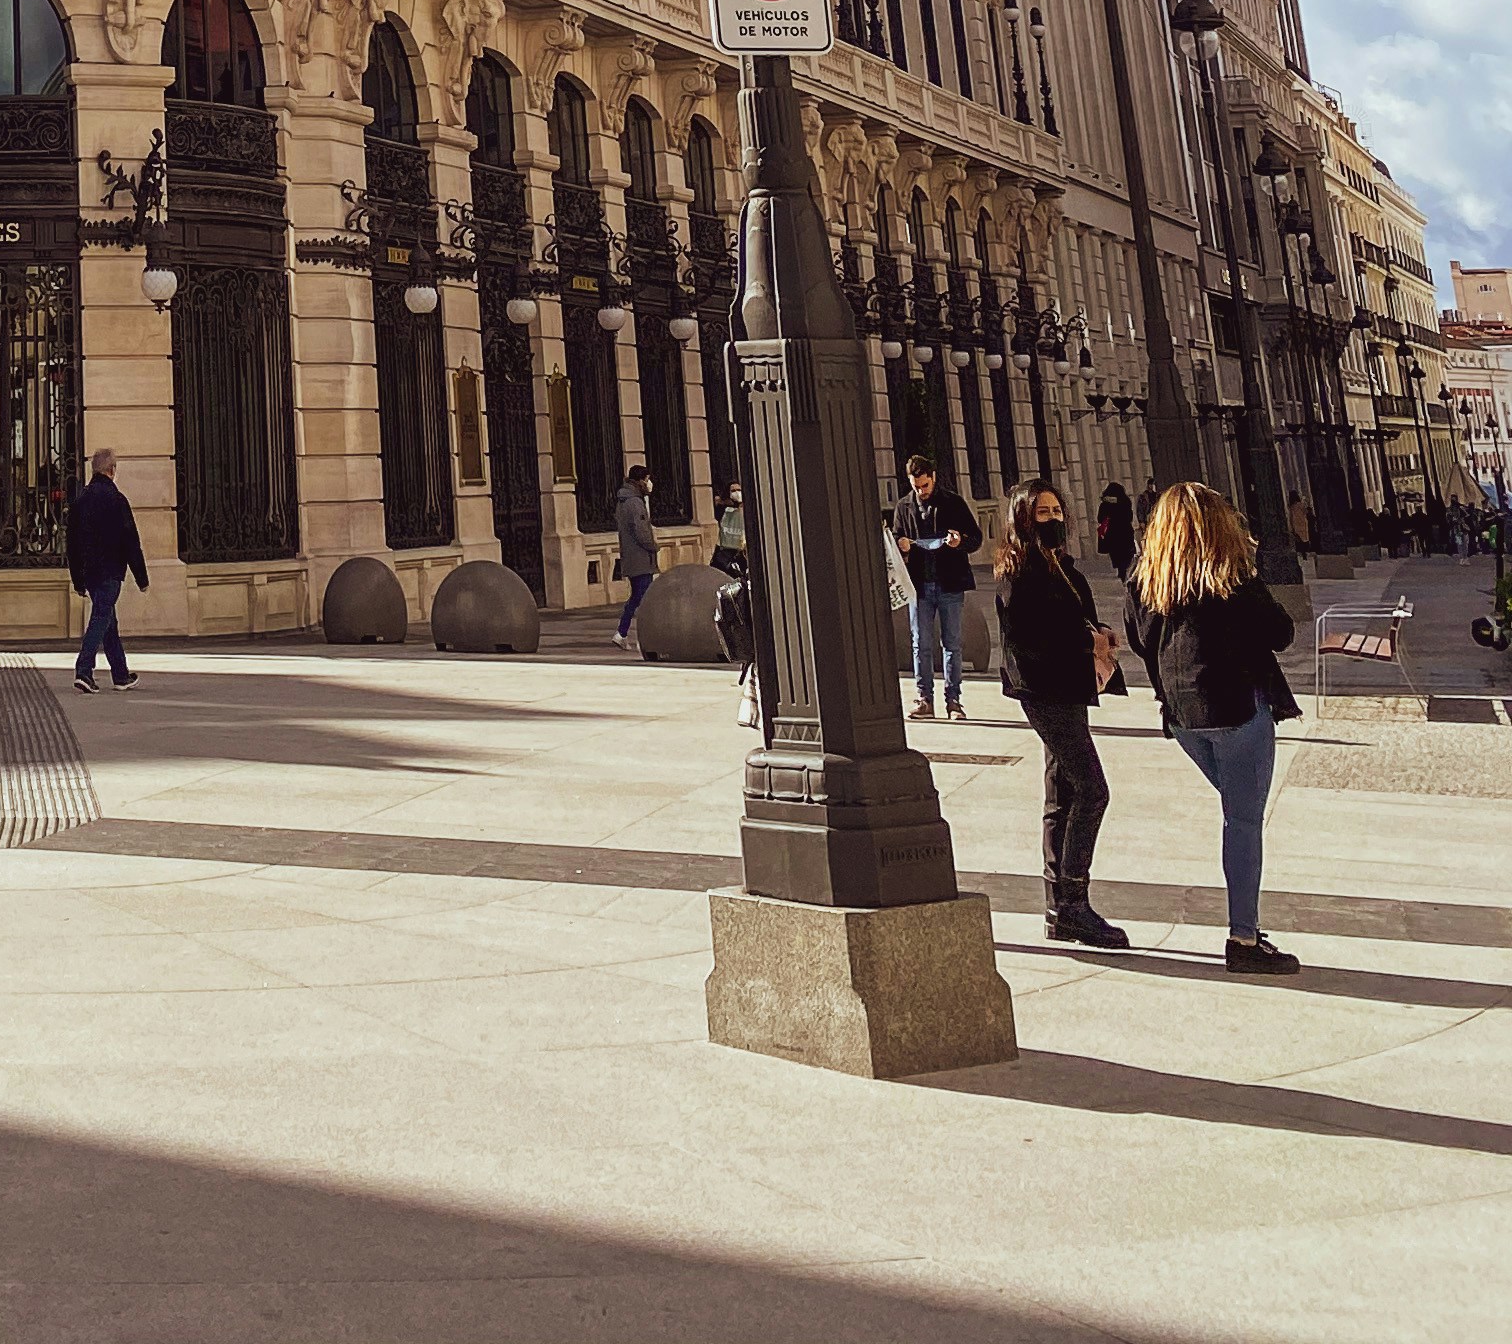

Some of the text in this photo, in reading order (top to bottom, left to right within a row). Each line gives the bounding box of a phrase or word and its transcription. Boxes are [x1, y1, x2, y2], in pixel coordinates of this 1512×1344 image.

[735, 6, 809, 21] VEHÍCULOS
[739, 25, 809, 37] DE MOTOR
